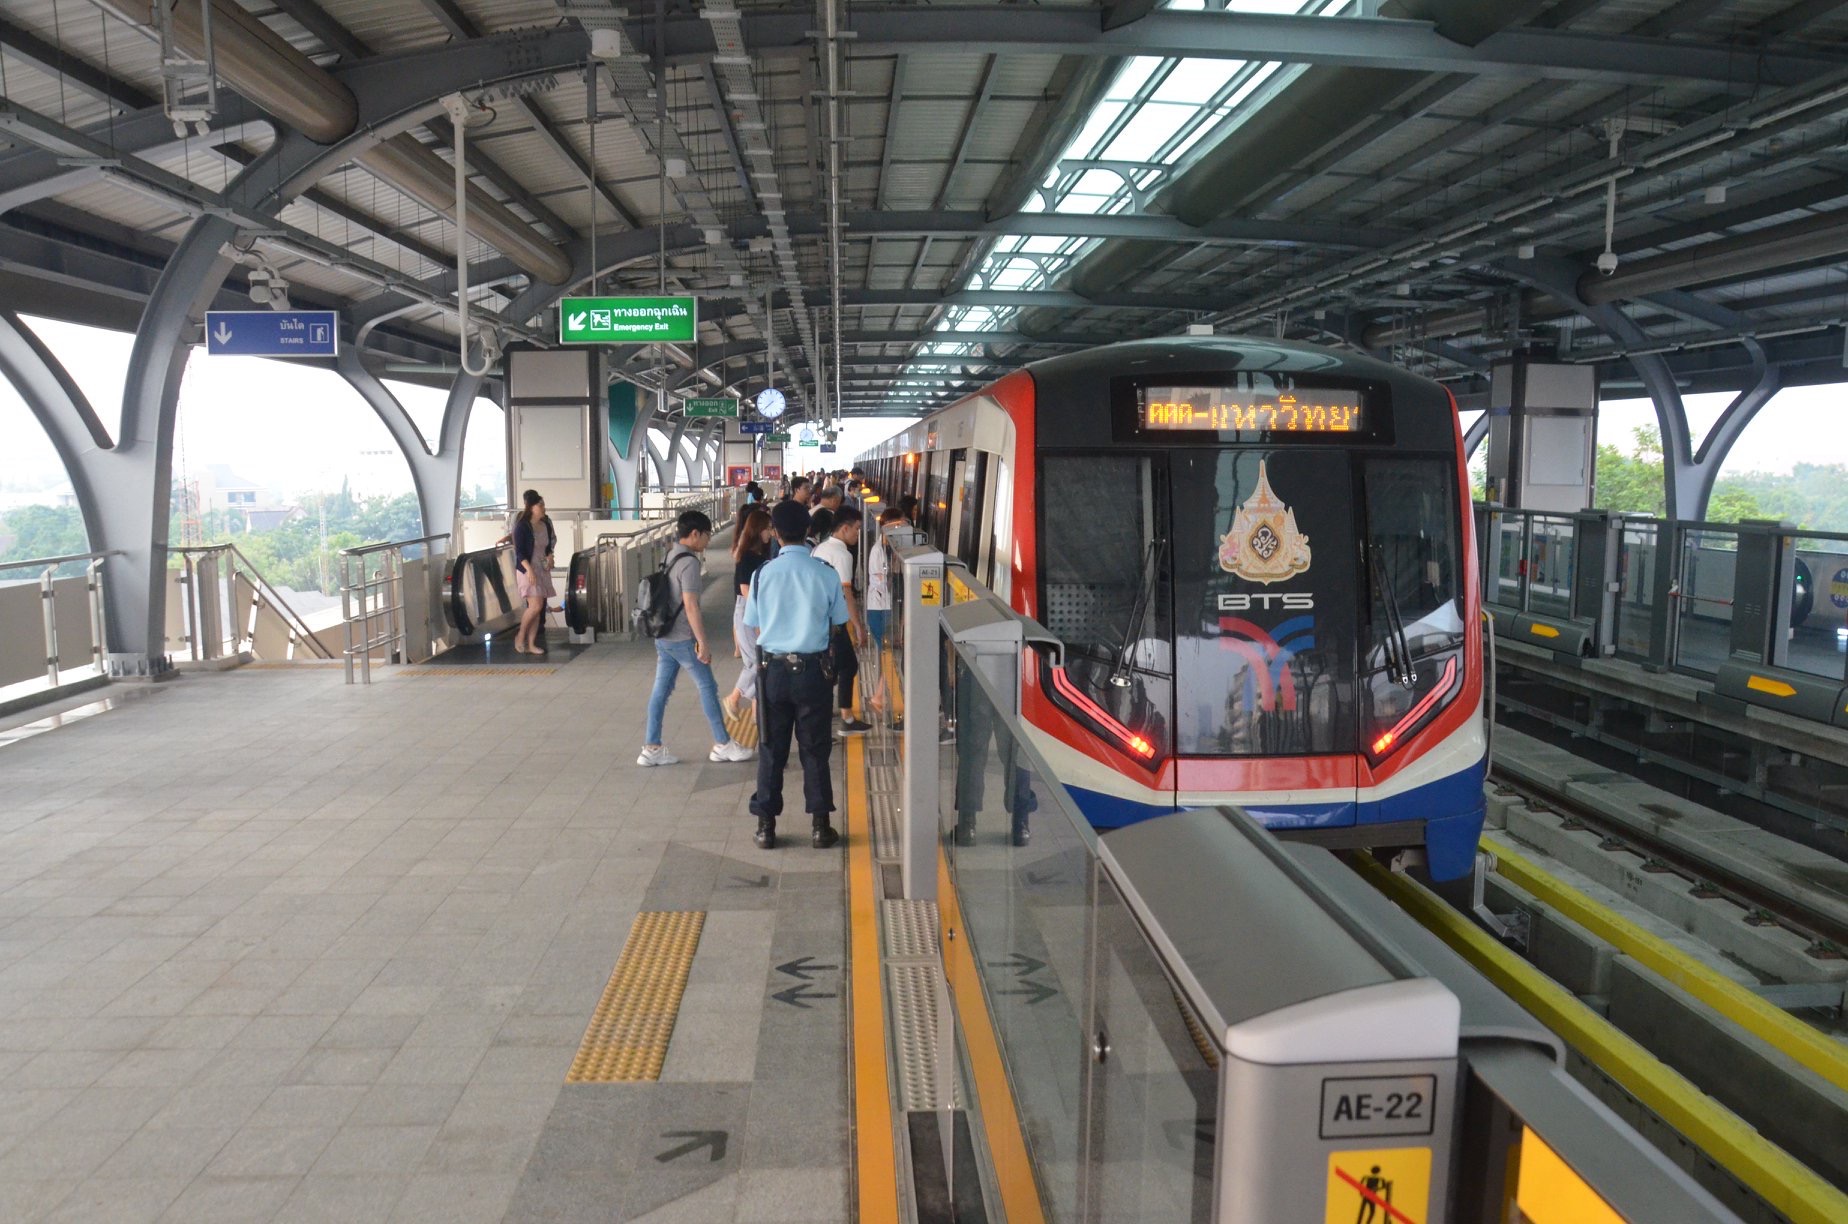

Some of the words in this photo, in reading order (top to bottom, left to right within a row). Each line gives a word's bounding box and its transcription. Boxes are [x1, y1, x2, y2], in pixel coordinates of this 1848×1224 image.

[613, 304, 688, 320] ทางออกฉุกเฉิน
[280, 318, 305, 330] บันได
[613, 323, 653, 332] Emergency
[654, 322, 669, 331] Exit
[1217, 592, 1315, 611] BTS
[1333, 1092, 1423, 1122] AE-22
